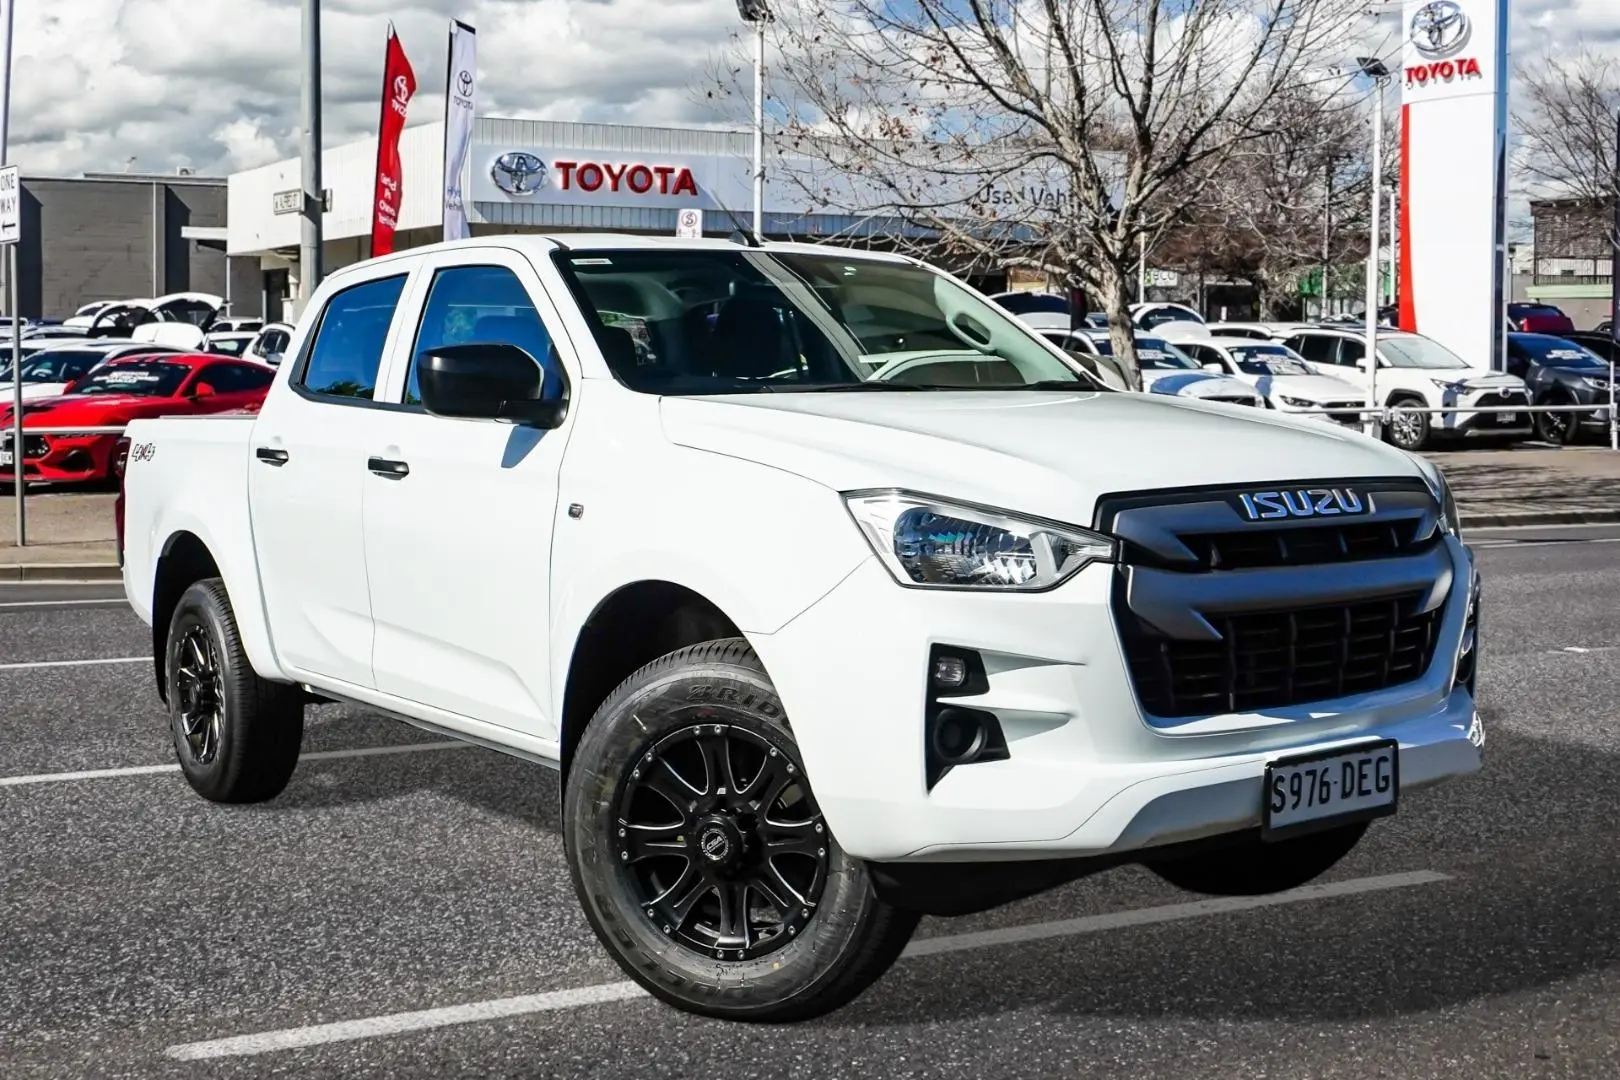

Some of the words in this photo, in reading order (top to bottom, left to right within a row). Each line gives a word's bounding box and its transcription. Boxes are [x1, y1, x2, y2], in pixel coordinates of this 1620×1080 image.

[1404, 57, 1481, 84] TOYOTA
[1, 172, 15, 192] ONE
[555, 161, 698, 196] TOYOTA
[1, 195, 16, 214] WAY
[1239, 488, 1363, 519] ISUZU
